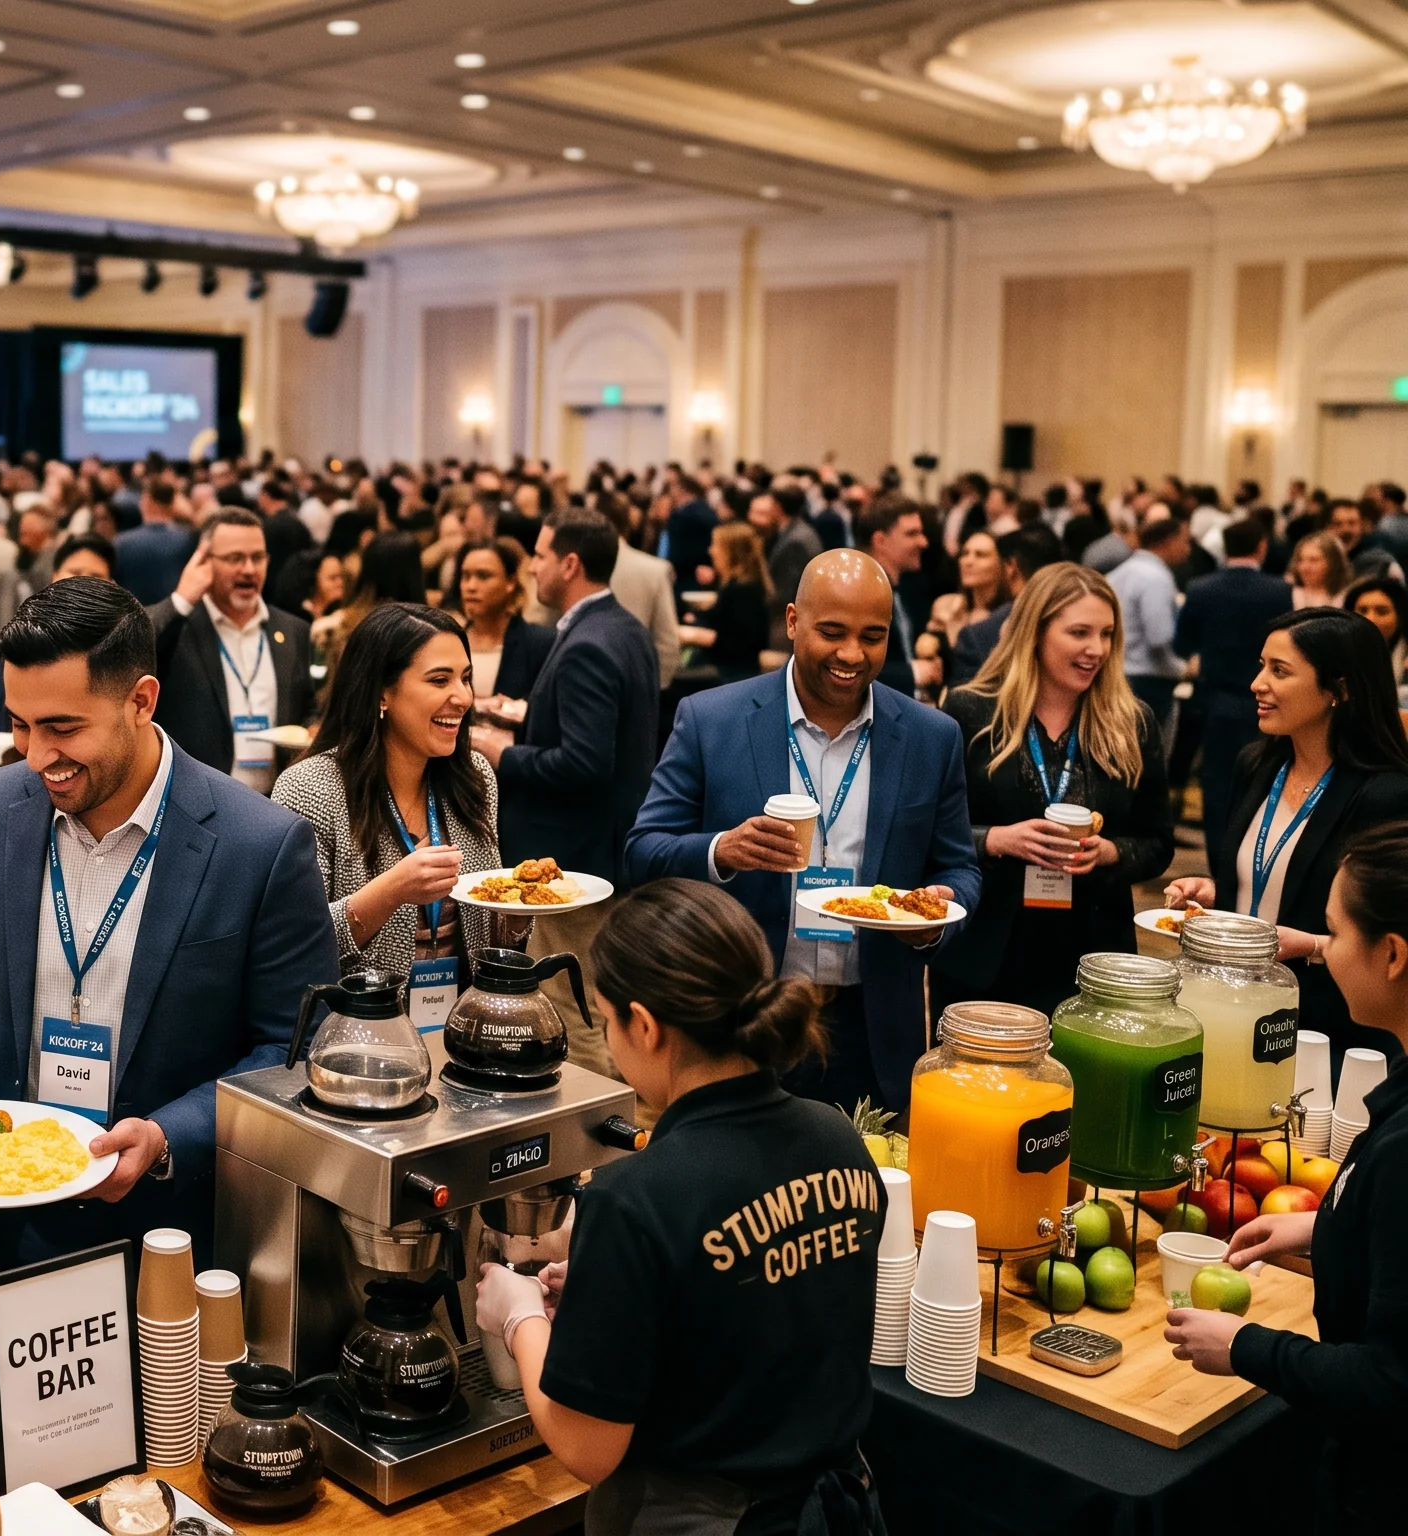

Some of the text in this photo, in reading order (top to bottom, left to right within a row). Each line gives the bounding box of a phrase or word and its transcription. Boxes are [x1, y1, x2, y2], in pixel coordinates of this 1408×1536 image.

[49, 1035, 103, 1053] KICKOFF '24
[57, 1065, 90, 1081] David
[1164, 1067, 1196, 1085] Green
[702, 1168, 879, 1272] STUMPTOWN
[764, 1217, 860, 1284] COFFEE
[8, 1310, 118, 1369] COFFEE
[37, 1357, 96, 1401] BAR
